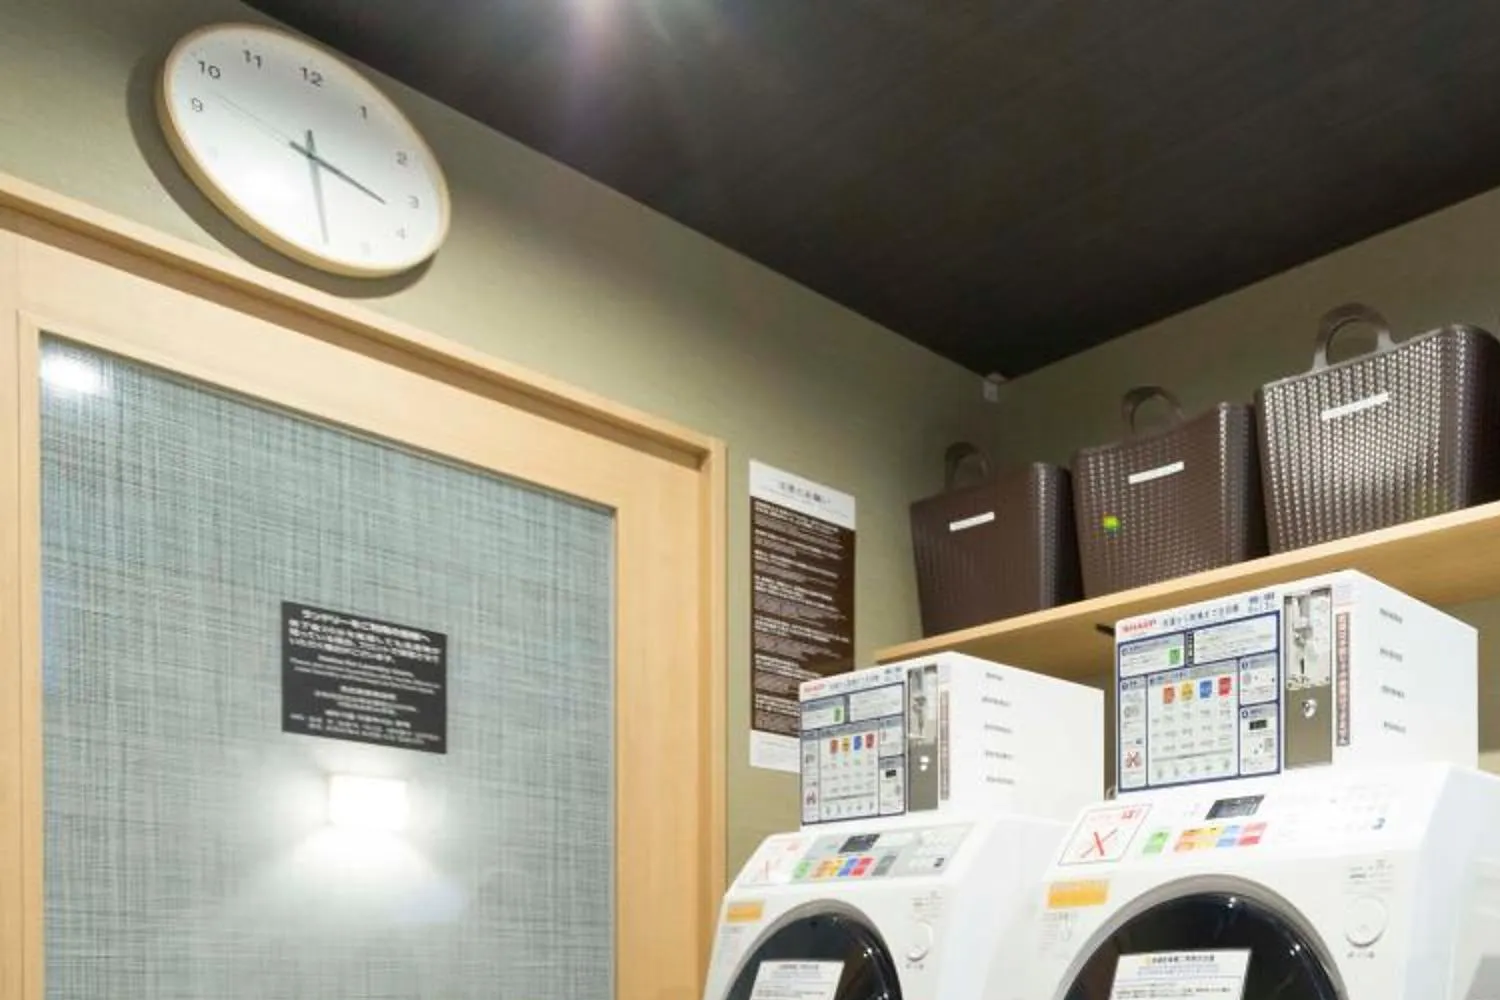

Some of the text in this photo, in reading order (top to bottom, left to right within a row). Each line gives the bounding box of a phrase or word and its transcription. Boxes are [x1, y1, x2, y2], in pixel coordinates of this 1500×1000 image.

[241, 48, 264, 70] 11
[196, 59, 222, 81] 10
[299, 66, 324, 88] 12
[190, 96, 205, 114] 9
[357, 104, 369, 120] 1
[395, 150, 408, 166] 2
[406, 194, 420, 210] 3
